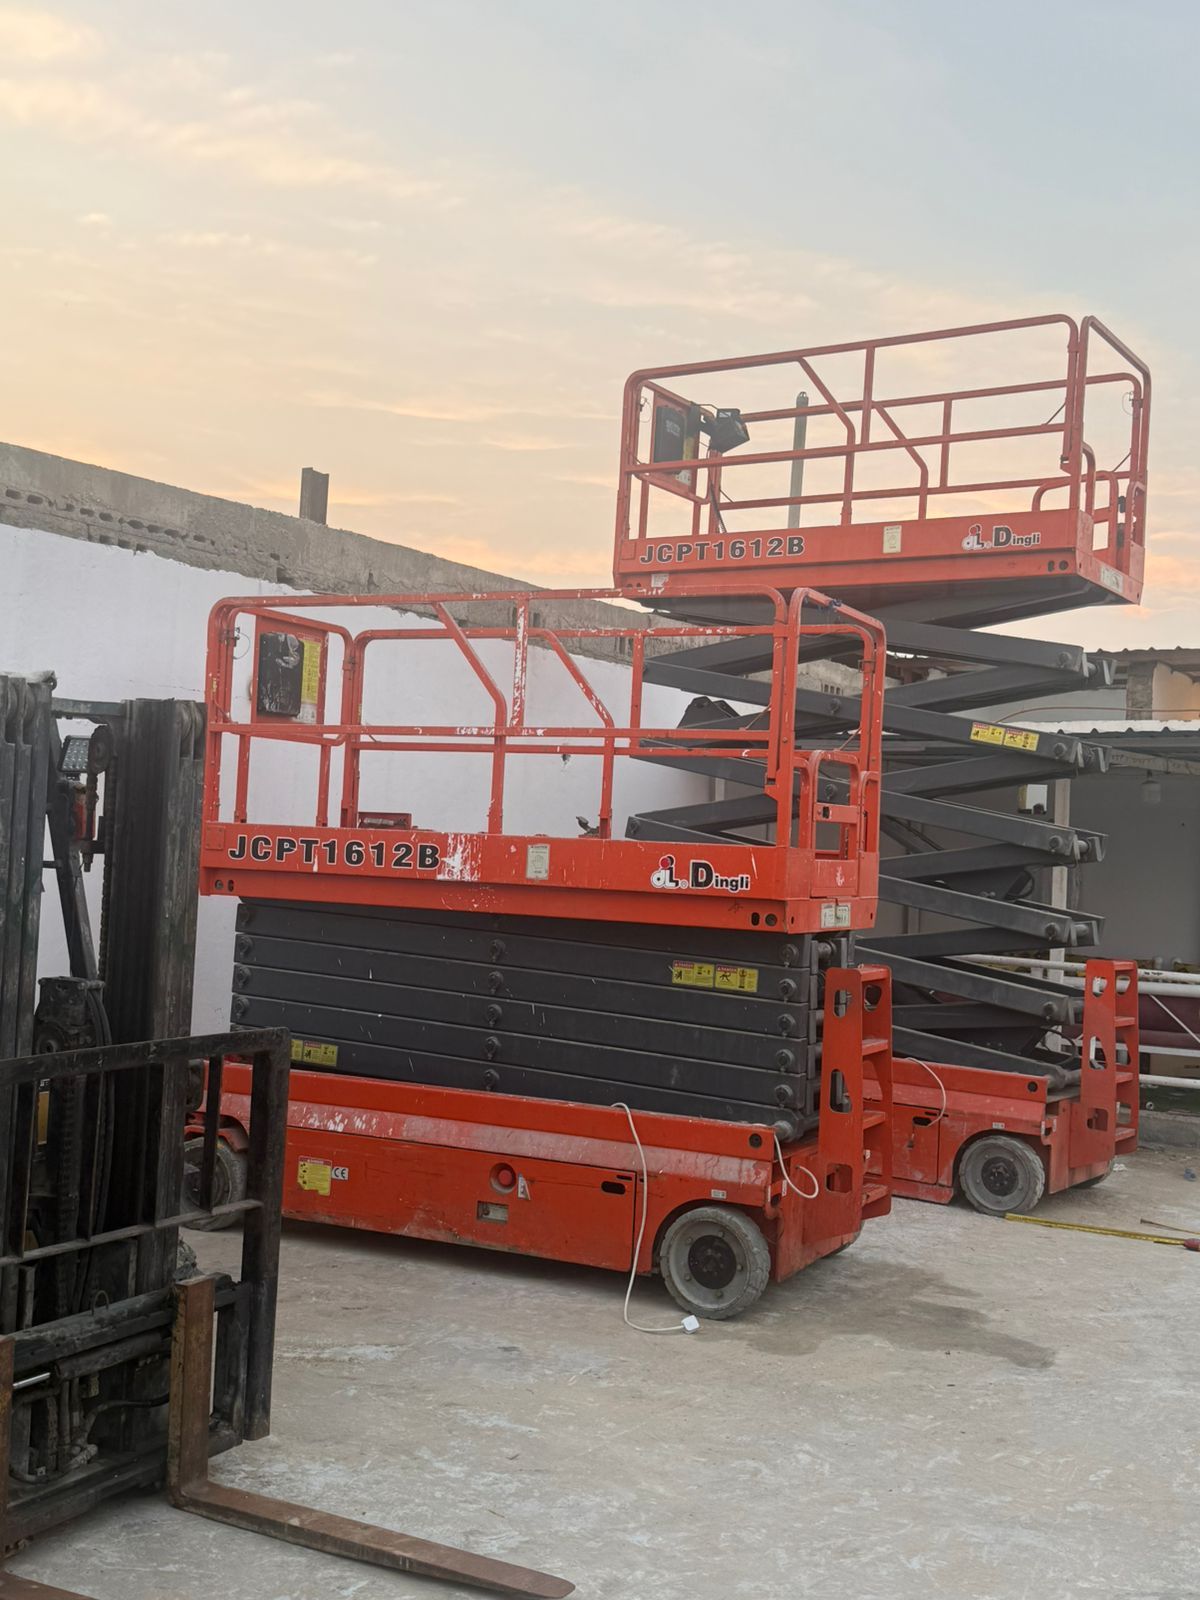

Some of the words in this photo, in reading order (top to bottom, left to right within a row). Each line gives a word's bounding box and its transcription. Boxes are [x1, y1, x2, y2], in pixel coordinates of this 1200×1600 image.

[640, 536, 804, 564] JCPT1612B
[993, 525, 1041, 547] Dingli
[228, 835, 440, 869] JCPT1612B
[690, 860, 750, 893] Dingli
[334, 1167, 346, 1179] CE
